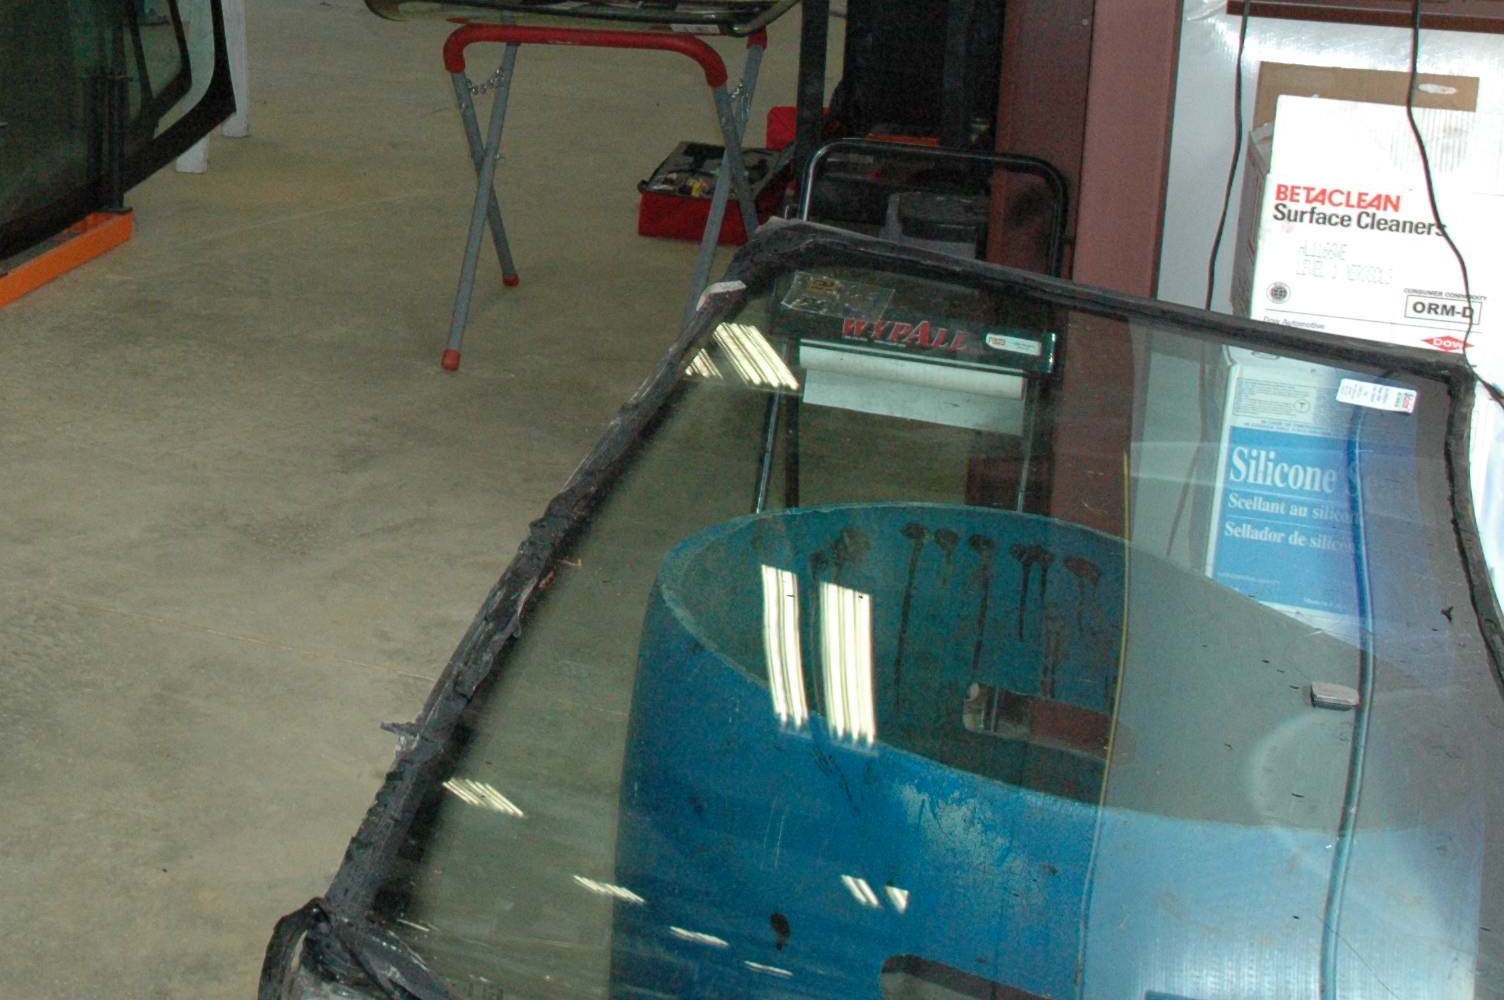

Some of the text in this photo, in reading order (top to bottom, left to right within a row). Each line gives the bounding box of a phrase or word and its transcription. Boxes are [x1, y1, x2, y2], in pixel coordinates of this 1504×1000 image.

[1275, 183, 1400, 213] BETACLEAN
[1273, 202, 1447, 237] Surface Cleaners
[1404, 287, 1443, 297] CONSUMER
[1412, 301, 1475, 319] ORM-D
[1229, 446, 1338, 494] Silicone
[1228, 493, 1286, 516] Scellant
[1289, 504, 1308, 517] au
[1224, 521, 1285, 544] Sellador
[1288, 531, 1307, 547] de
